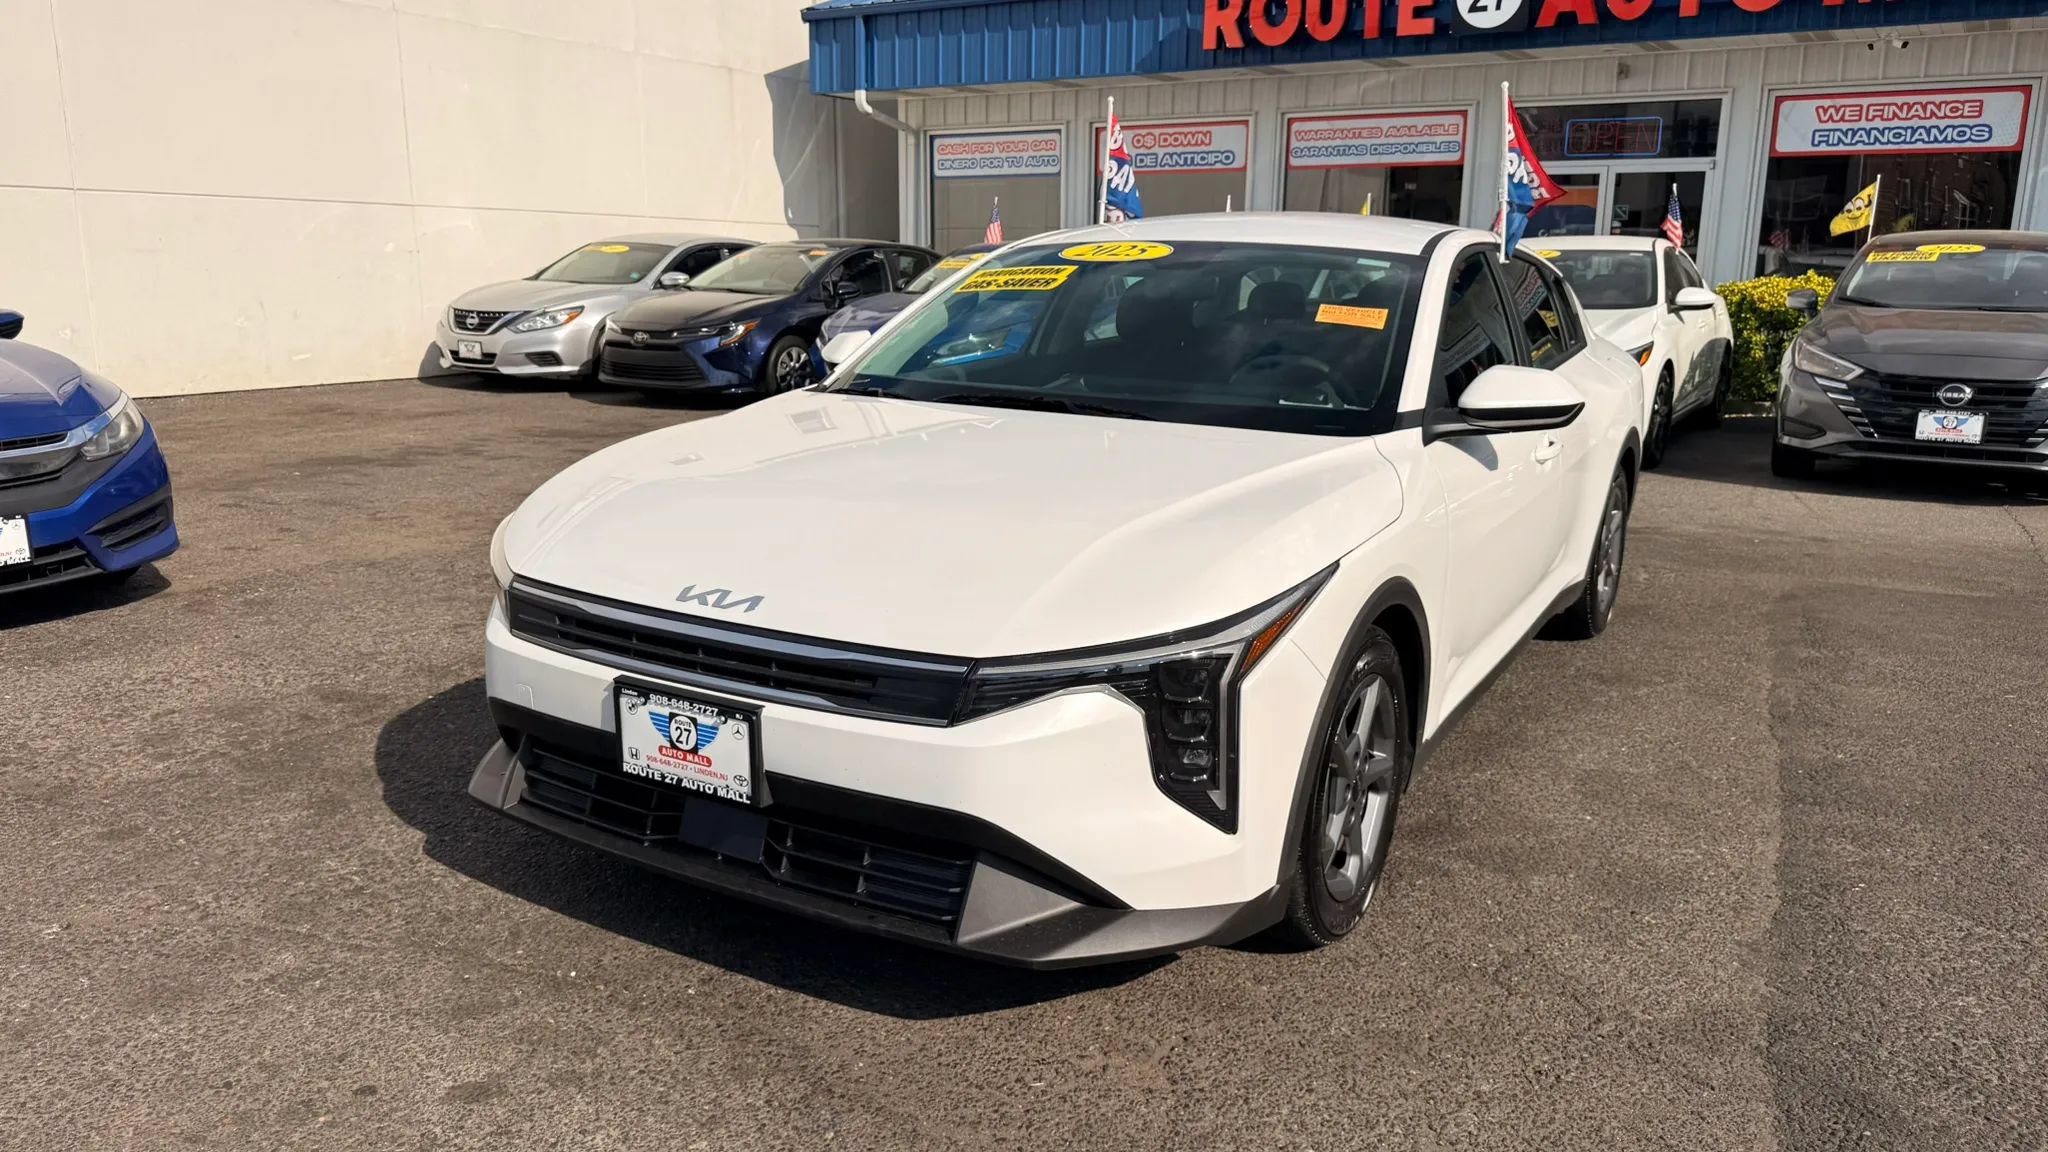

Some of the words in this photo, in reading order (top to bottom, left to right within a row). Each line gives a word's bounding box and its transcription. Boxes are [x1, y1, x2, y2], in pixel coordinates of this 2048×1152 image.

[1816, 105, 1861, 123] WE
[1865, 100, 1984, 121] FINANCE
[1158, 130, 1212, 148] DOWN
[1385, 123, 1459, 138] AVAILABLE
[1812, 124, 1992, 146] FINANCIAMOS
[938, 143, 969, 155] CASH
[971, 142, 994, 154] FOR
[996, 140, 1028, 153] YOUR
[1031, 139, 1056, 152] CAR
[1291, 145, 1366, 159] GARANTIAS
[1369, 141, 1461, 156] DISPONIBLES
[938, 158, 977, 169] DINERO
[979, 157, 1004, 169] POR
[1006, 157, 1023, 169] TU
[1024, 155, 1058, 168] AUTO
[1135, 152, 1158, 168] DE
[1159, 150, 1235, 167] ANTICIPO
[974, 267, 1067, 278] NAVIGATION
[675, 584, 765, 613] KIA
[649, 693, 718, 716] 908-648-2727
[674, 718, 692, 728] ROUTE
[675, 726, 692, 746] 27
[661, 747, 684, 760] AUTO
[686, 753, 709, 766] MALL
[623, 762, 662, 781] ROUTE
[664, 773, 678, 785] 27
[681, 778, 714, 794] AUTO
[717, 787, 750, 804] MALL
